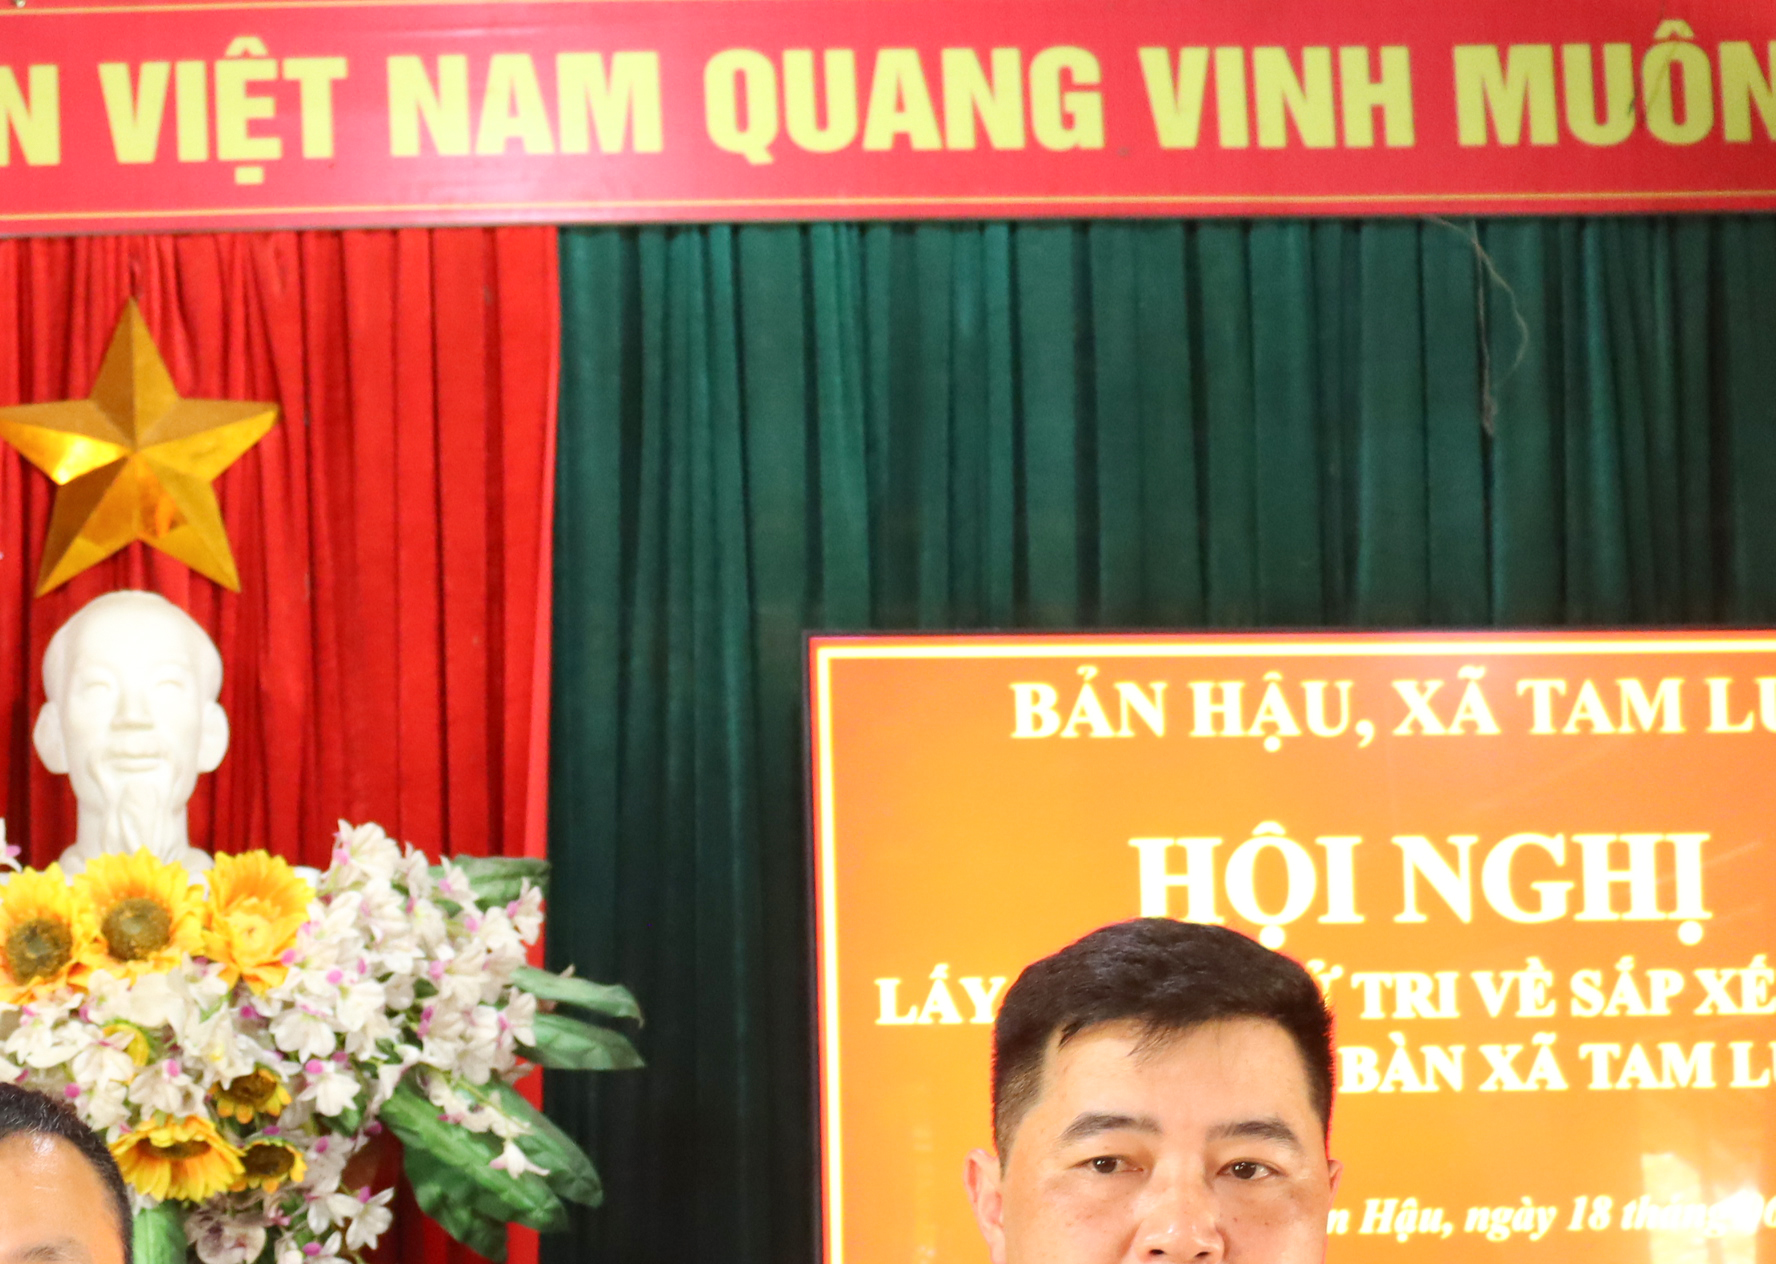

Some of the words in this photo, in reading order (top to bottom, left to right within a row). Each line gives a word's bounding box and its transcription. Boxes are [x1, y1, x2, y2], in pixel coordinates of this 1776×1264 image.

[98, 36, 348, 185] VIỆT
[387, 51, 663, 158] NAM
[703, 45, 1106, 166] QUANG
[1137, 45, 1416, 150] VINH
[1452, 18, 1776, 147] MUÔN
[1008, 664, 1168, 740] BẢN
[1187, 669, 1376, 753] HẬU,
[1391, 664, 1503, 737] XÃ
[1515, 677, 1687, 736] TAM
[1127, 820, 1365, 950] HỘI
[1391, 832, 1713, 946] NGHỊ
[874, 963, 1007, 1026] LẤY
[1350, 970, 1461, 1019] TRI
[1470, 956, 1557, 1018] VỀ
[1337, 1031, 1466, 1094] BÀN
[1478, 1031, 1569, 1092] XÃ
[1578, 1041, 1717, 1090] TAM
[1358, 1196, 1454, 1243] Hậu,
[1464, 1195, 1558, 1242] ngày
[1567, 1194, 1614, 1232] 18
